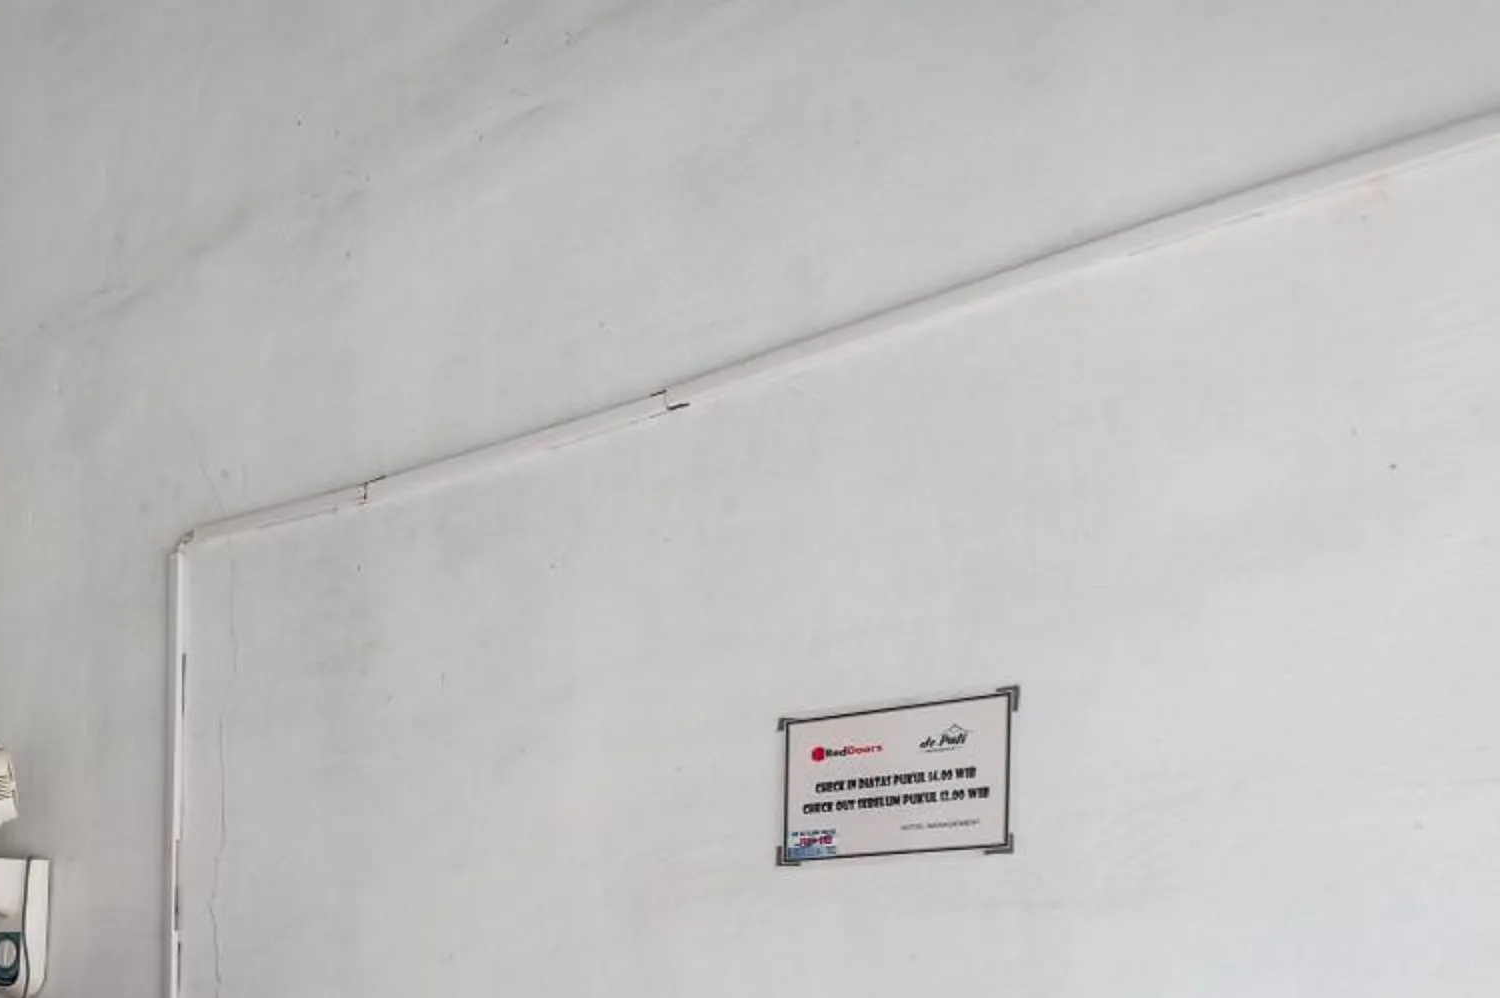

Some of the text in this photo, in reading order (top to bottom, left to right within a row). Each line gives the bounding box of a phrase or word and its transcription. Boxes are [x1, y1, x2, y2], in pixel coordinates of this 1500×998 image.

[815, 779, 845, 793] CHECK
[847, 779, 857, 790] IN
[893, 770, 926, 785] PUKUL
[927, 768, 953, 782] 14.00
[955, 766, 977, 779] WIB
[803, 801, 833, 814] CHECK
[835, 799, 855, 811] OUT
[902, 791, 938, 805] PUKUL
